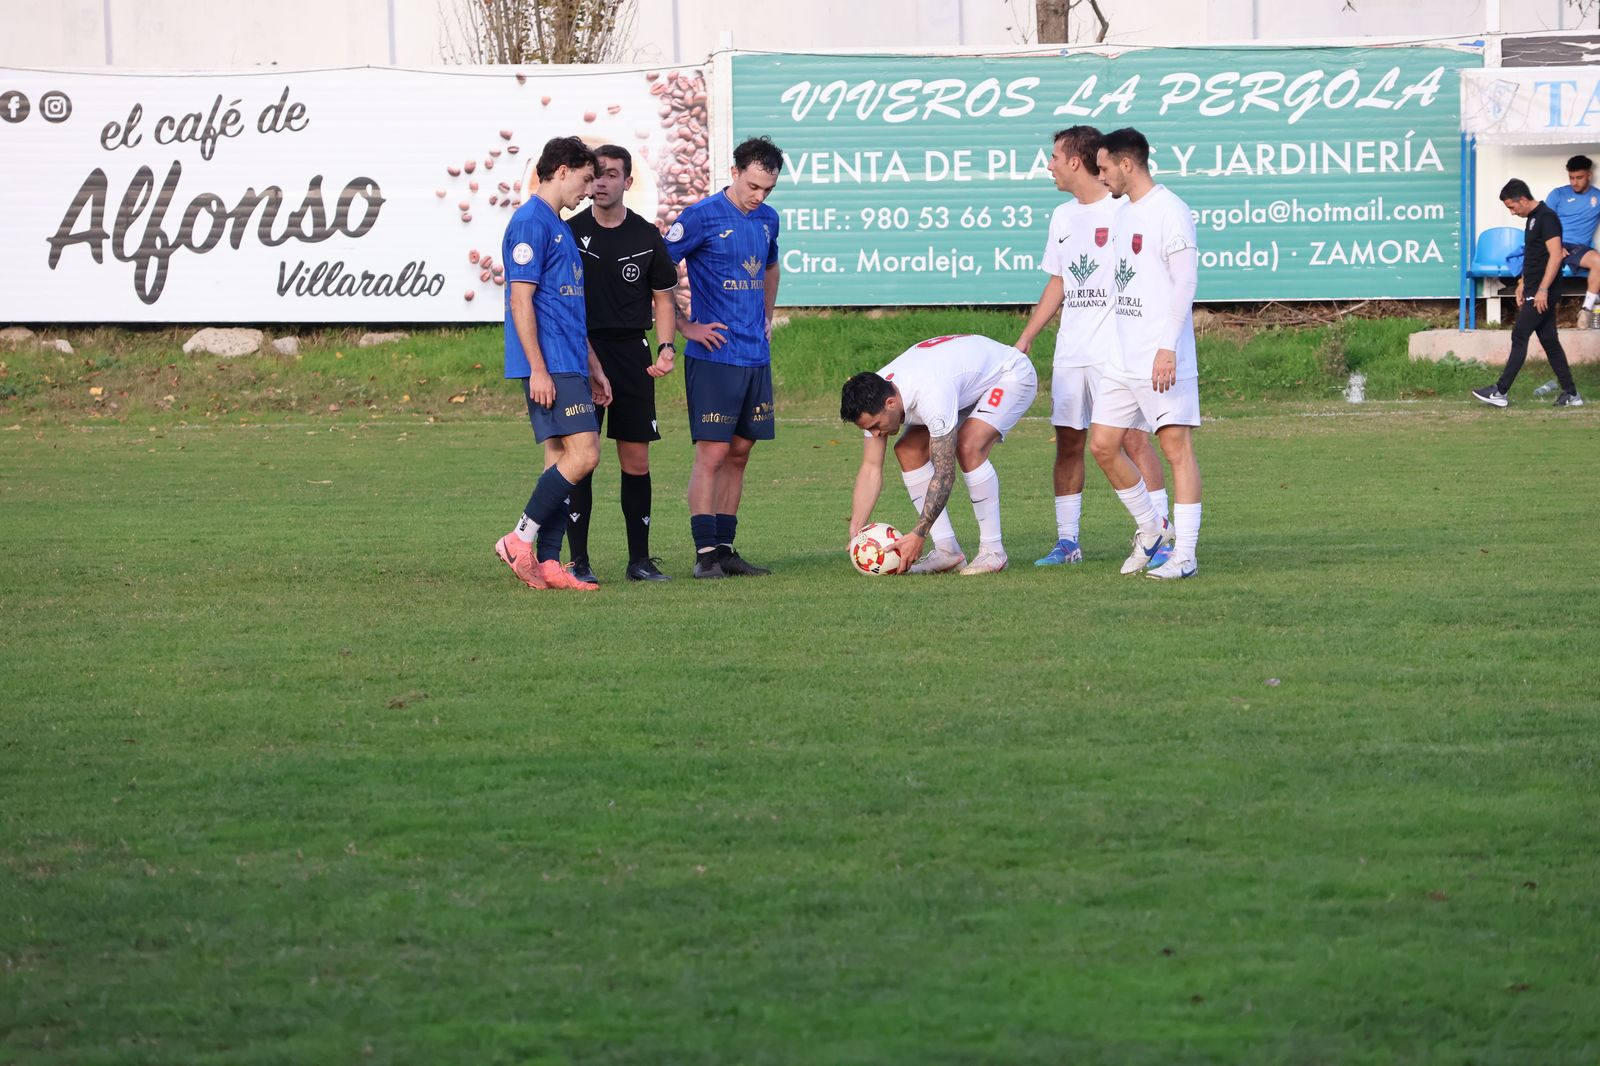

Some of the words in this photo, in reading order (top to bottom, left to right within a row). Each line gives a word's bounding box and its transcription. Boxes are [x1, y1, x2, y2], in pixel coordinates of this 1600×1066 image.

[780, 77, 1041, 123] VIVEROS
[1053, 74, 1141, 118] LA
[1159, 66, 1446, 125] PERGOLA
[100, 102, 143, 151] el
[154, 94, 245, 161] café
[257, 85, 310, 134] de
[783, 150, 911, 185] VENTA
[924, 149, 972, 182] DE
[1171, 144, 1196, 177] Y
[1206, 129, 1445, 176] JARDINERÍA
[46, 159, 386, 305] Alfonso
[783, 207, 850, 230] TELF.:
[860, 206, 910, 230] 980
[918, 206, 950, 229] 53
[959, 205, 992, 228] 66
[1001, 205, 1033, 228] 33
[1191, 196, 1445, 231] ergola@hotmail.com
[783, 249, 845, 273] Ctra.
[856, 246, 982, 279] Moraleja,
[994, 247, 1042, 272] Km.
[1308, 239, 1445, 266] ZAMORA
[275, 260, 446, 298] Villaralbo
[1077, 288, 1108, 299] RURAL
[1118, 296, 1143, 308] RURAL
[987, 387, 1004, 408] 8
